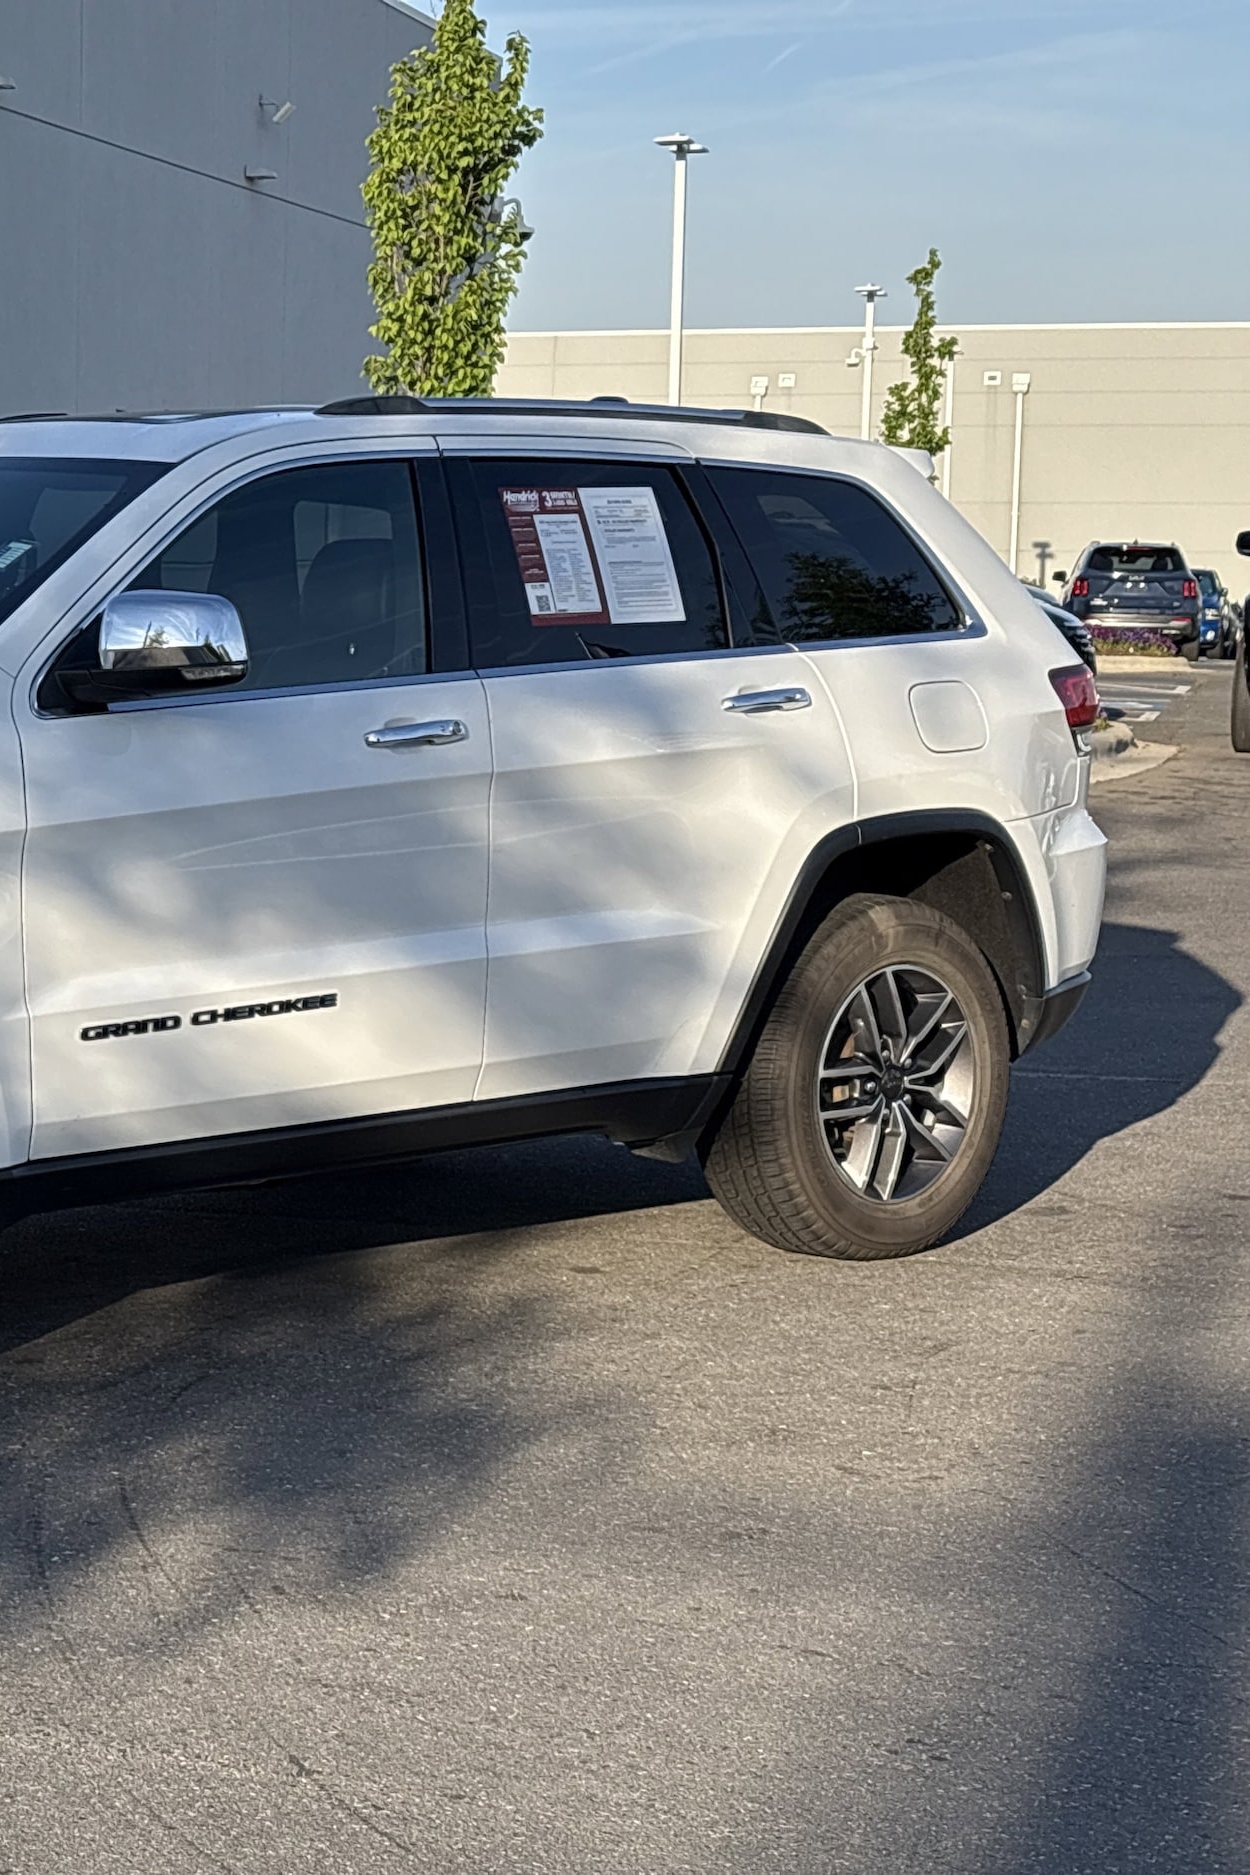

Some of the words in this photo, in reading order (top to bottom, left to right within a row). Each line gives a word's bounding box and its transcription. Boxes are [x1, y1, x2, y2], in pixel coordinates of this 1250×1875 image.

[541, 491, 552, 507] 3
[80, 1015, 181, 1041] GRAND
[190, 993, 338, 1026] CHEROKEE
